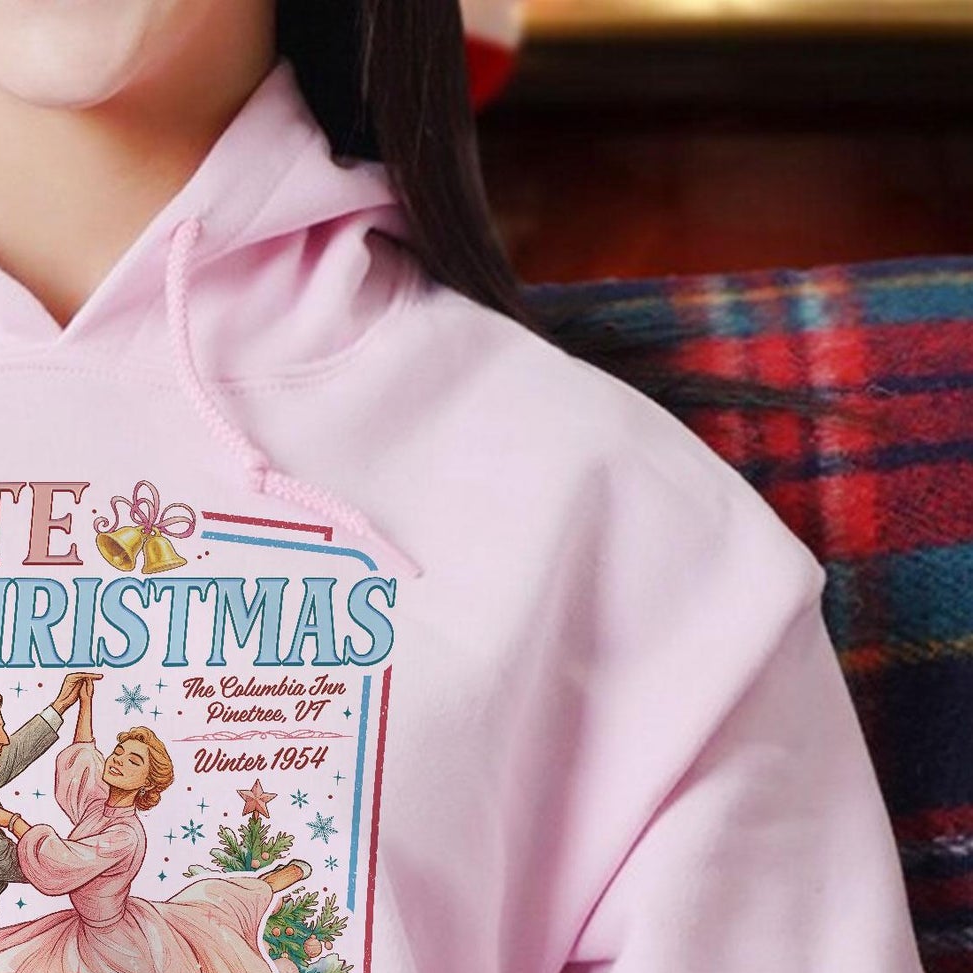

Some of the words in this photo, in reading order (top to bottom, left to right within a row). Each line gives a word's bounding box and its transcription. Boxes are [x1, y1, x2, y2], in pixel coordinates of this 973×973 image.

[182, 676, 216, 699] The
[219, 675, 307, 698] Columbia
[308, 673, 347, 696] Inn
[206, 701, 288, 724] Pinetree,
[294, 699, 331, 722] VT
[193, 746, 268, 774] Winter
[270, 745, 329, 771] 1954
